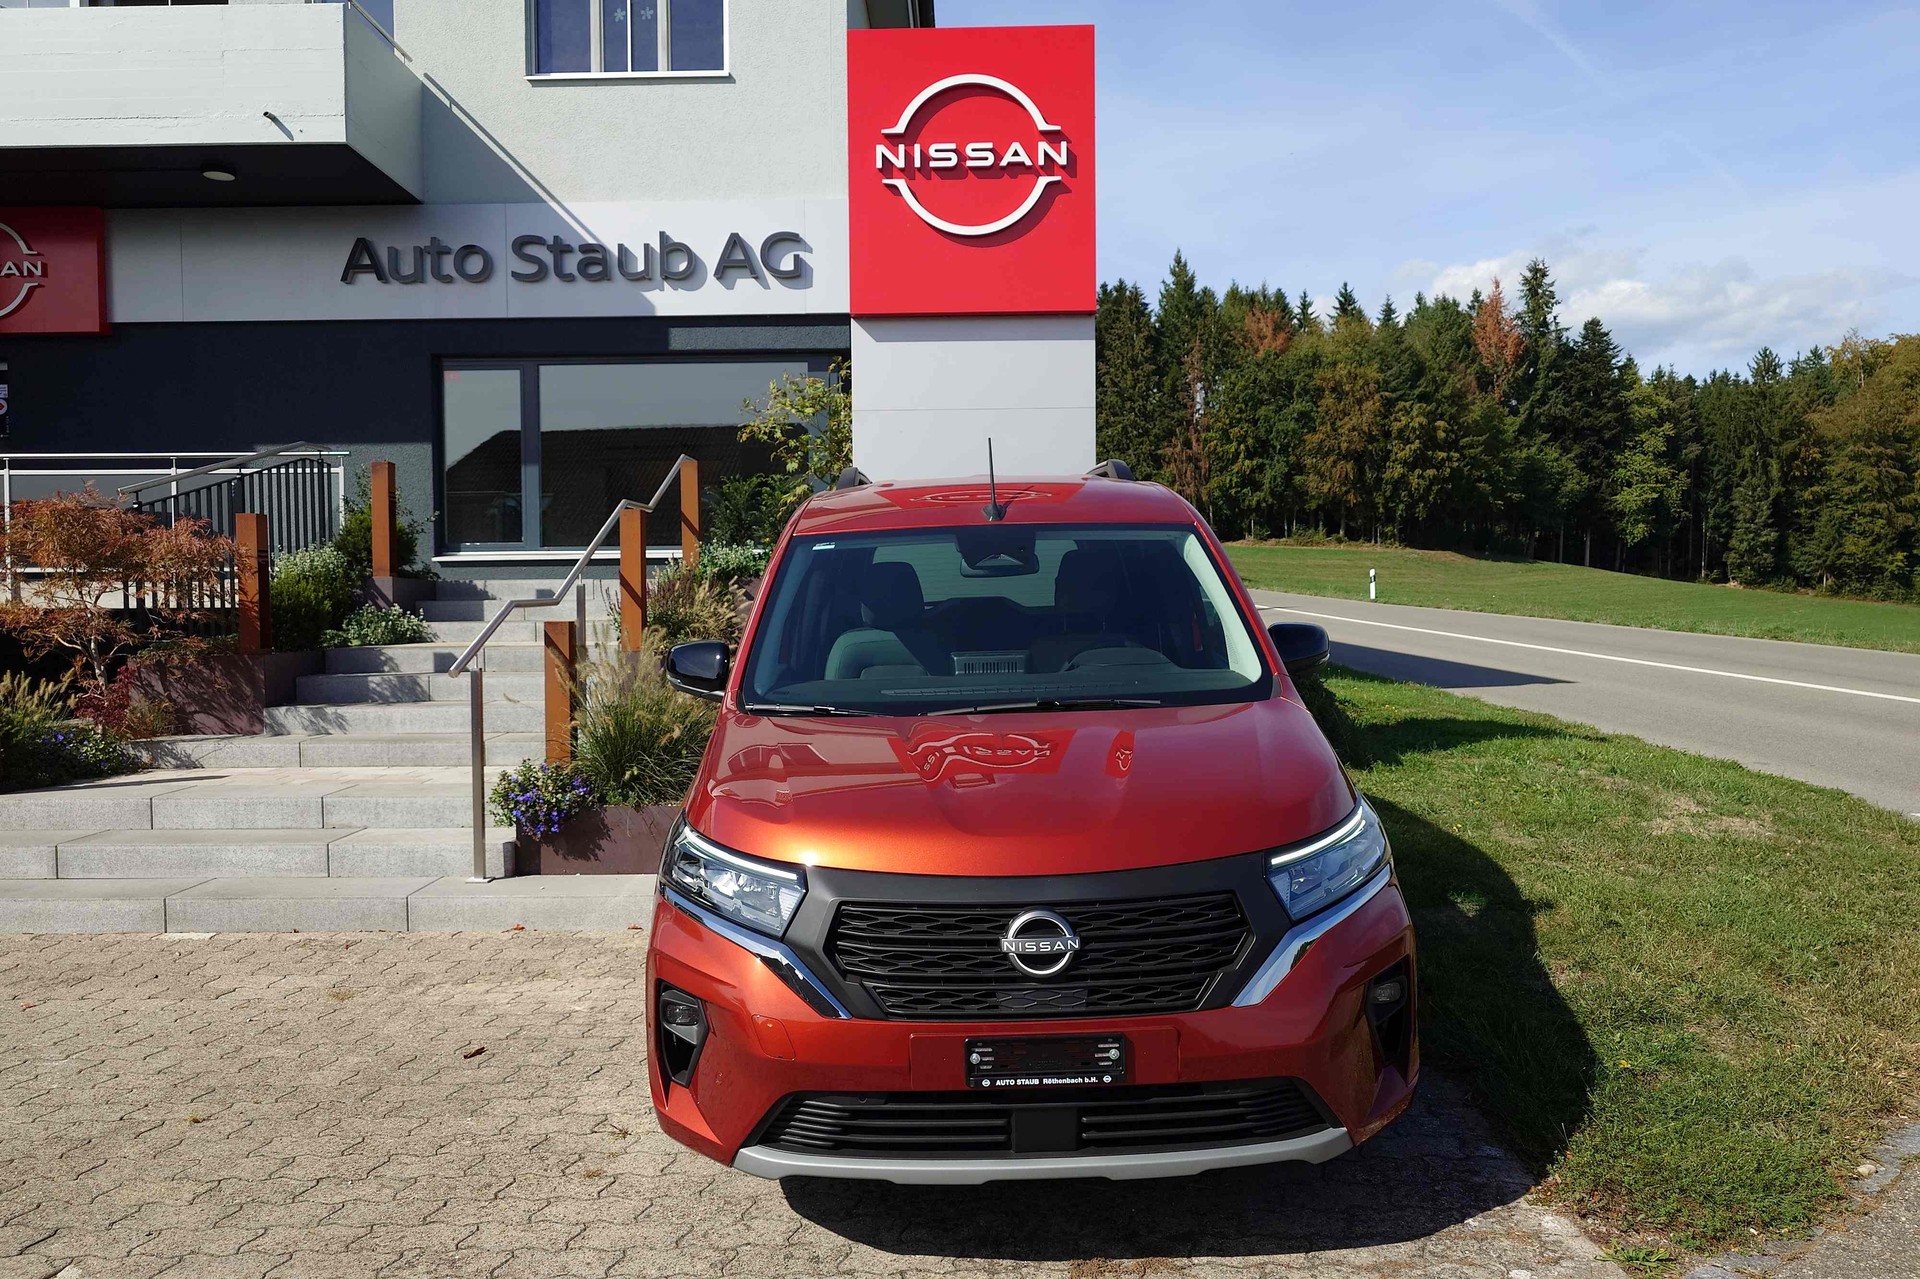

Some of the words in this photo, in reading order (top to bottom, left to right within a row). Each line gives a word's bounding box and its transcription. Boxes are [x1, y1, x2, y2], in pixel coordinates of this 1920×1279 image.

[875, 141, 1067, 169] NISSAN
[340, 236, 493, 284] Auto
[510, 230, 696, 283] Staub
[713, 231, 802, 280] AG
[1003, 939, 1079, 952] NISSAN
